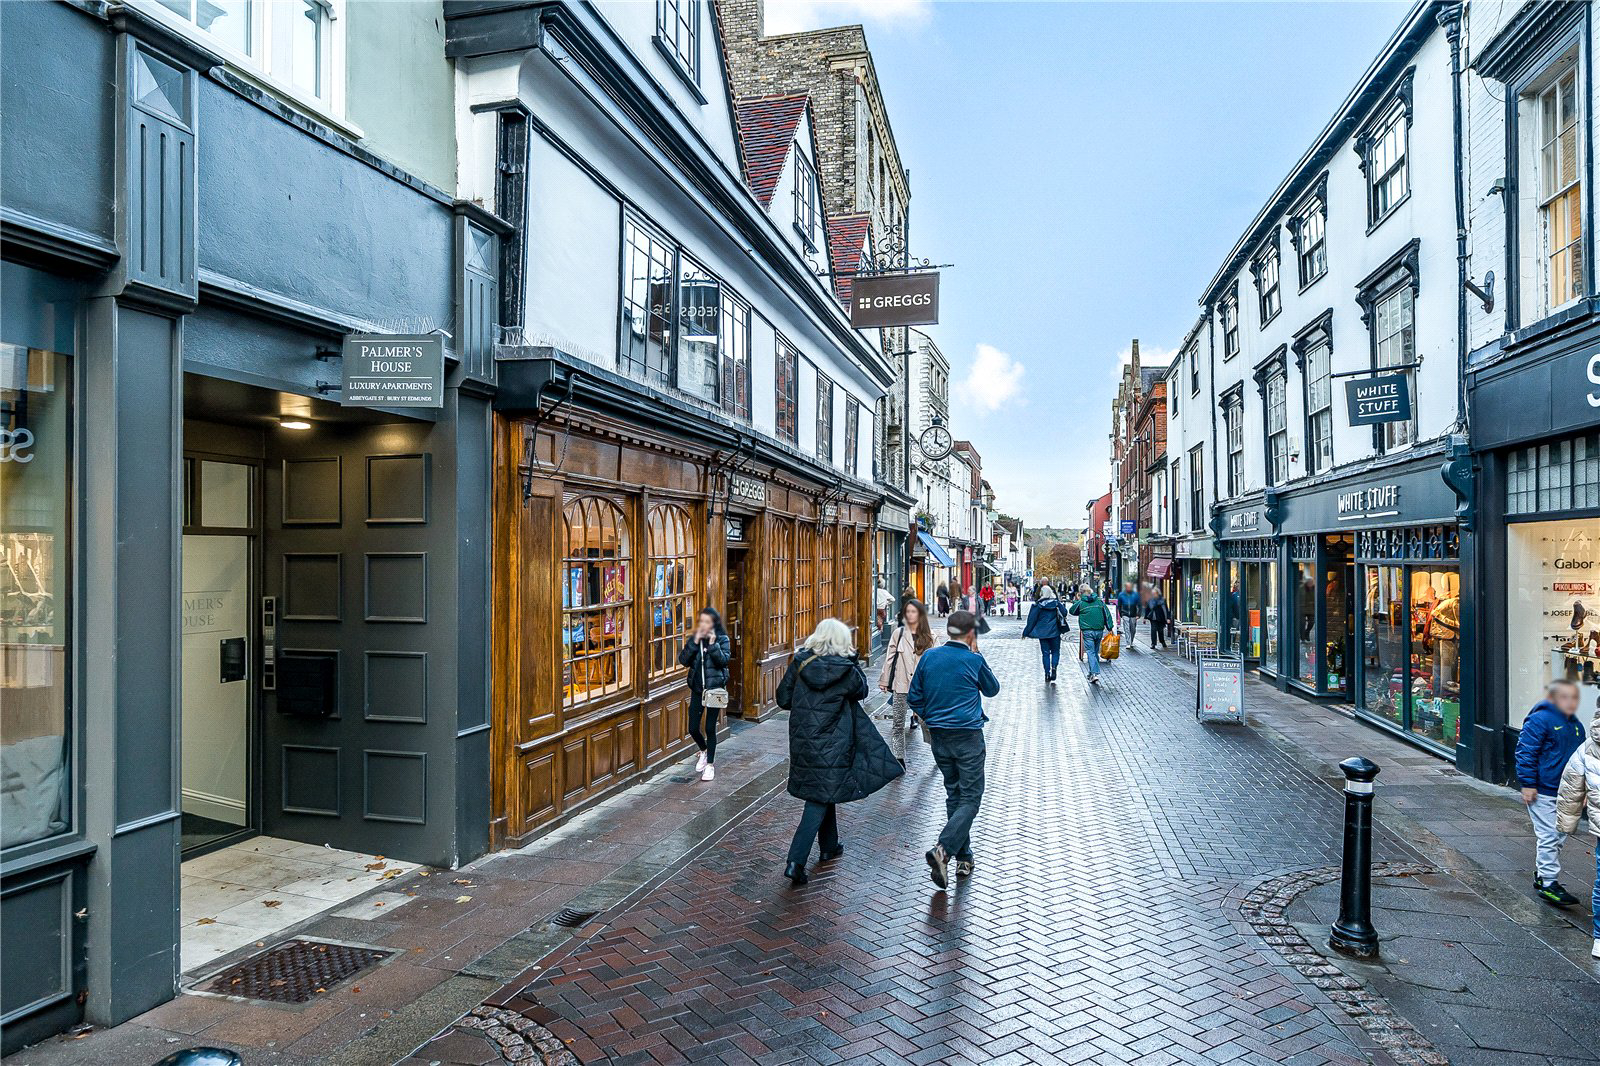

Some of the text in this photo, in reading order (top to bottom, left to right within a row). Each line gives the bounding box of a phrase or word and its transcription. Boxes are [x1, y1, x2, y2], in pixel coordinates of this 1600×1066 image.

[874, 294, 931, 308] GREGGS
[361, 346, 422, 357] PALMER'S
[371, 361, 412, 372] HOUSE
[1357, 384, 1397, 398] WHITE
[1358, 400, 1398, 414] STUFF
[1338, 485, 1398, 514] WHITE STUFF
[1230, 511, 1259, 528] WHITE STUFF
[1554, 558, 1594, 569] Gabor
[1554, 583, 1585, 591] PIKOLINOS
